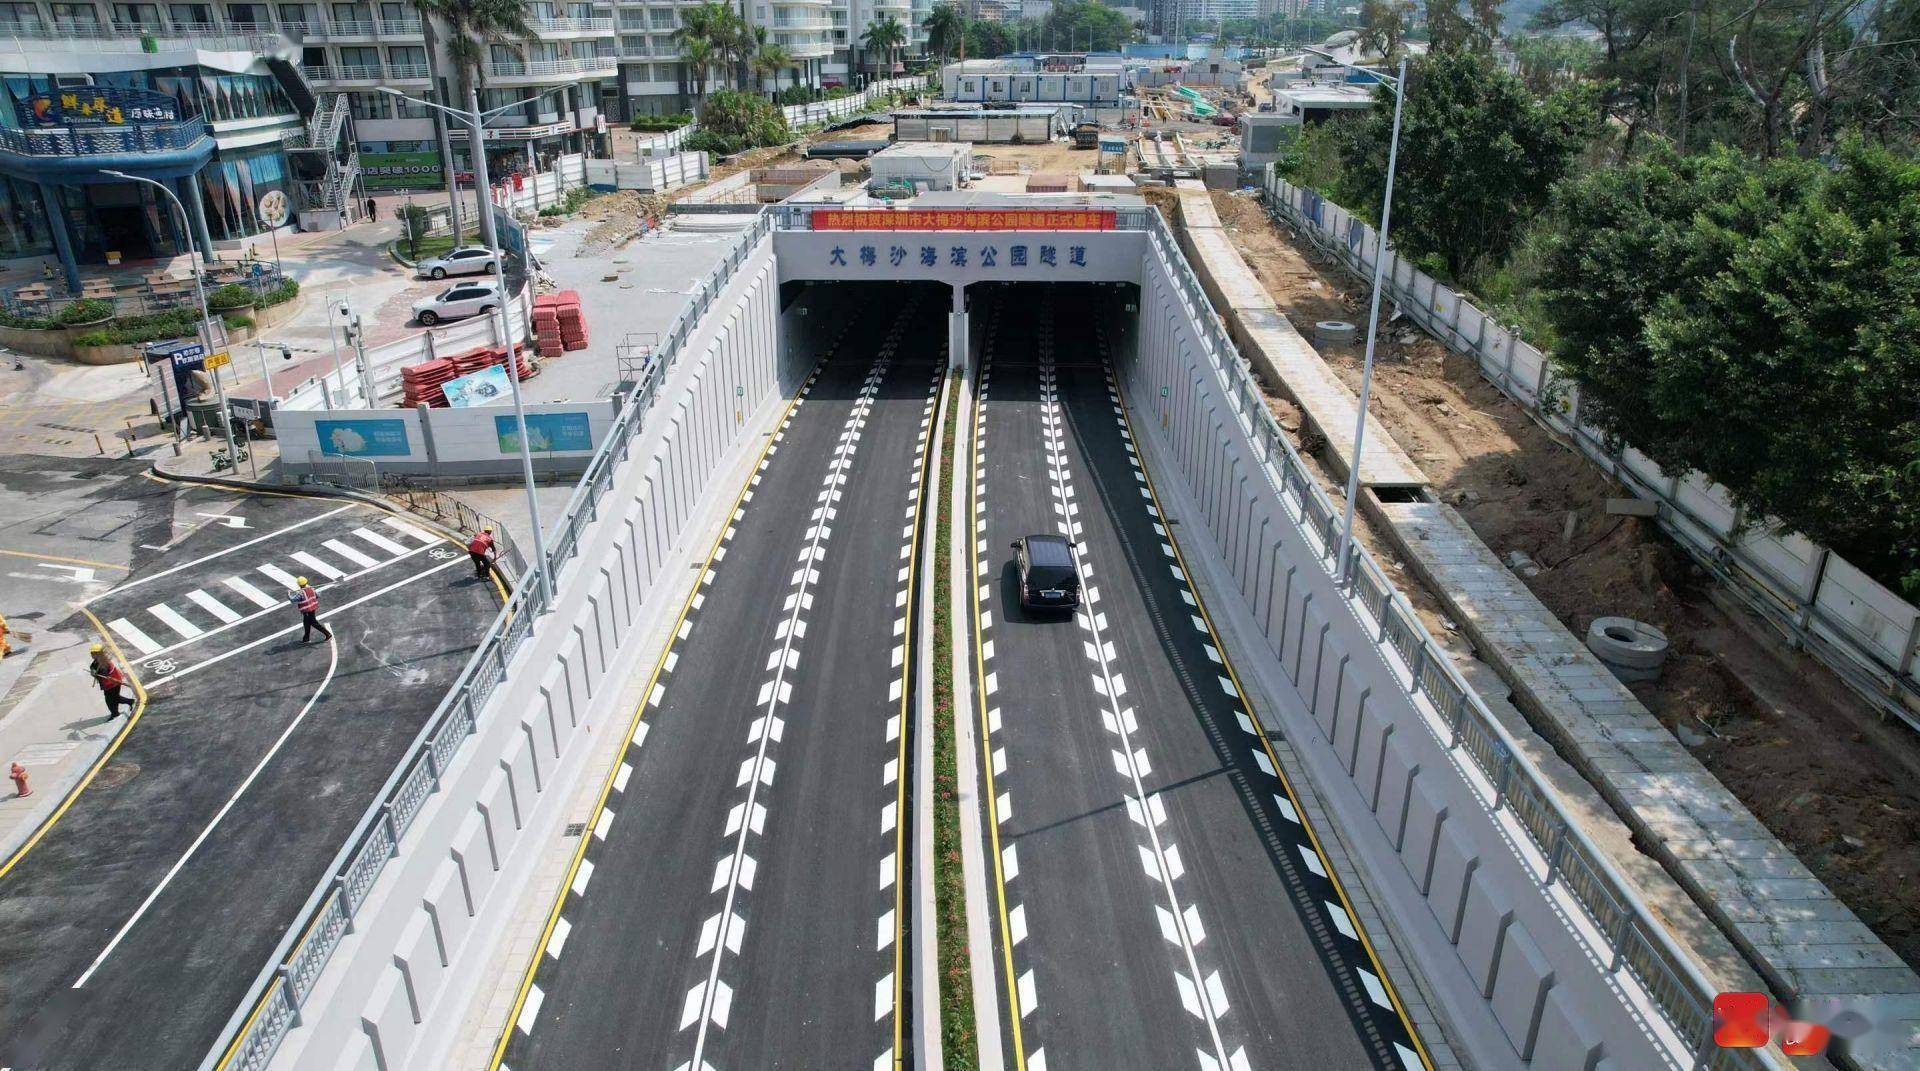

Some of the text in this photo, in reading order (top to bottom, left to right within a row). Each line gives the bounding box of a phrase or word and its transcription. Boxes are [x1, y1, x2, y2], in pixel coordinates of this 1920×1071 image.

[827, 213, 1101, 227] 热烈祝贺深圳市大梅沙海滨公园隧道正式通车
[829, 245, 1088, 267] 大梅沙海滨公园隧道
[174, 353, 183, 365] P
